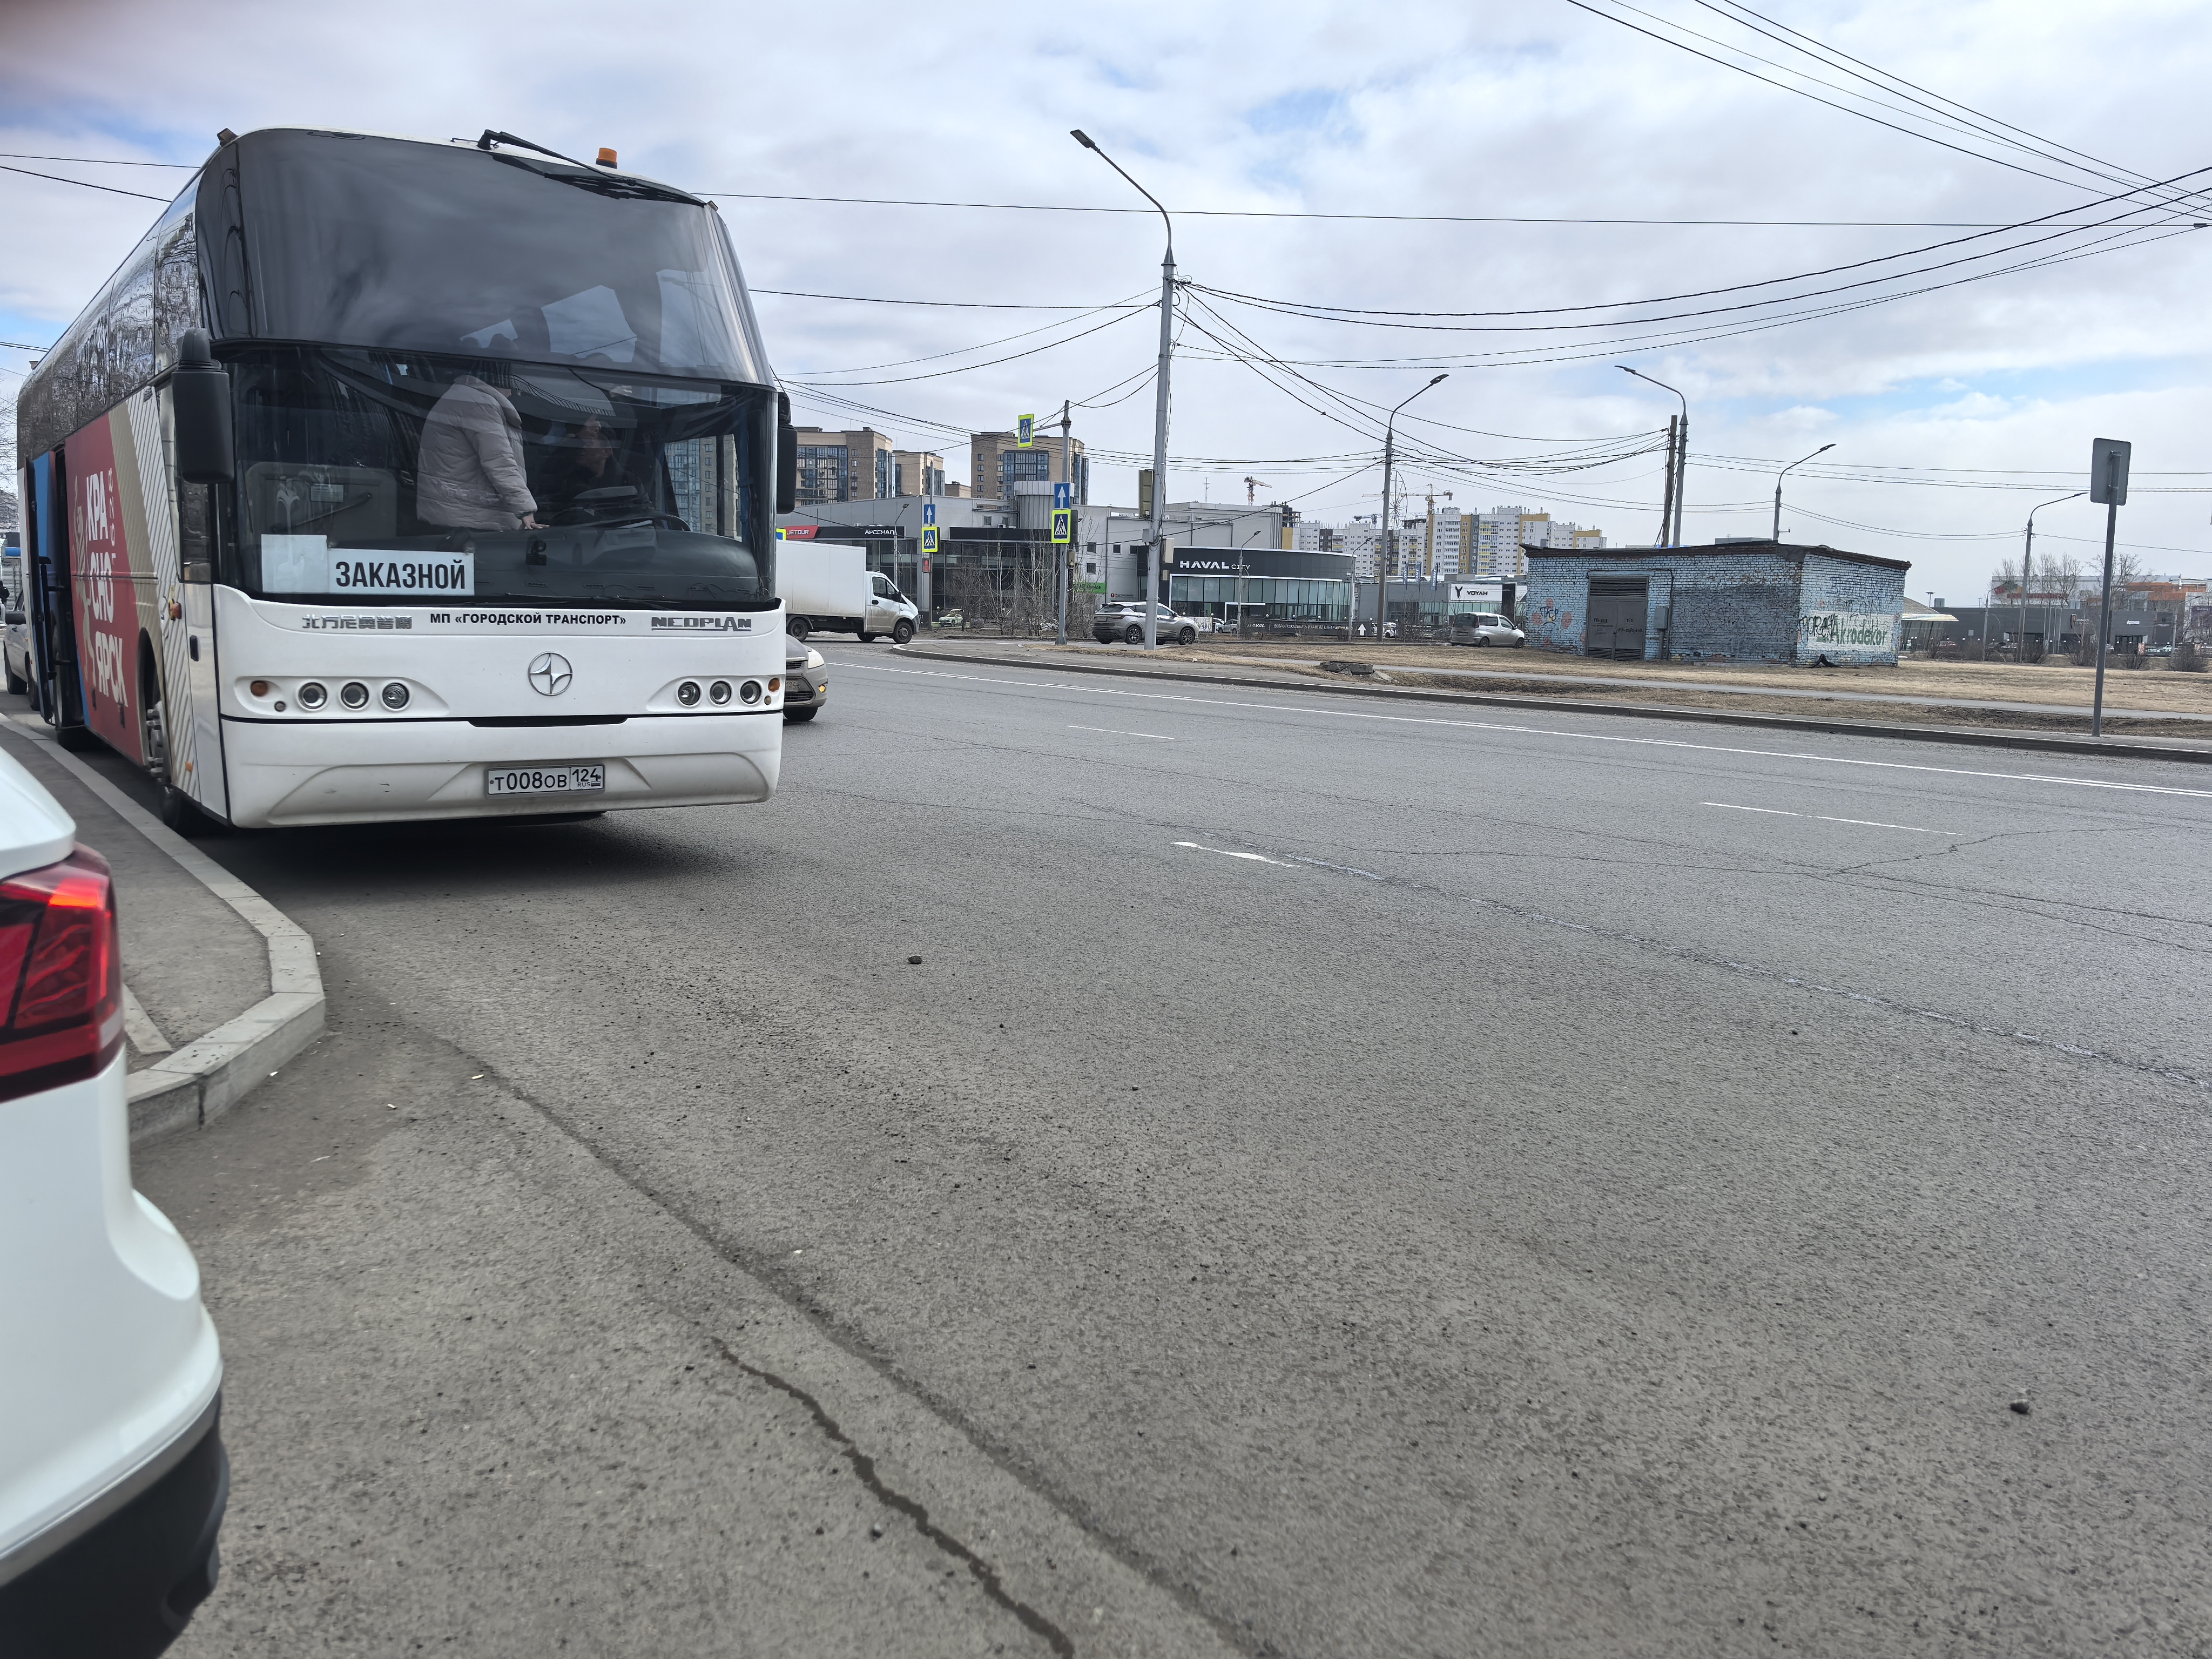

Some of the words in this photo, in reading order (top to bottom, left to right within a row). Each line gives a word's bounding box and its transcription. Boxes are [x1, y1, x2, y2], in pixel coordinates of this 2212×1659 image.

[86, 471, 109, 541] КРА
[335, 559, 466, 590] ЗАКАЗНОЙ
[1179, 561, 1230, 569] HAVAL
[90, 552, 114, 623] СНО
[430, 613, 450, 624] МП
[455, 612, 542, 625] «ГОРОДСКОЙ
[545, 613, 626, 625] ТРАНСПОРТ»
[651, 617, 752, 631] NEOPLAN
[95, 631, 129, 707] ЯРСК
[572, 768, 599, 783] 124
